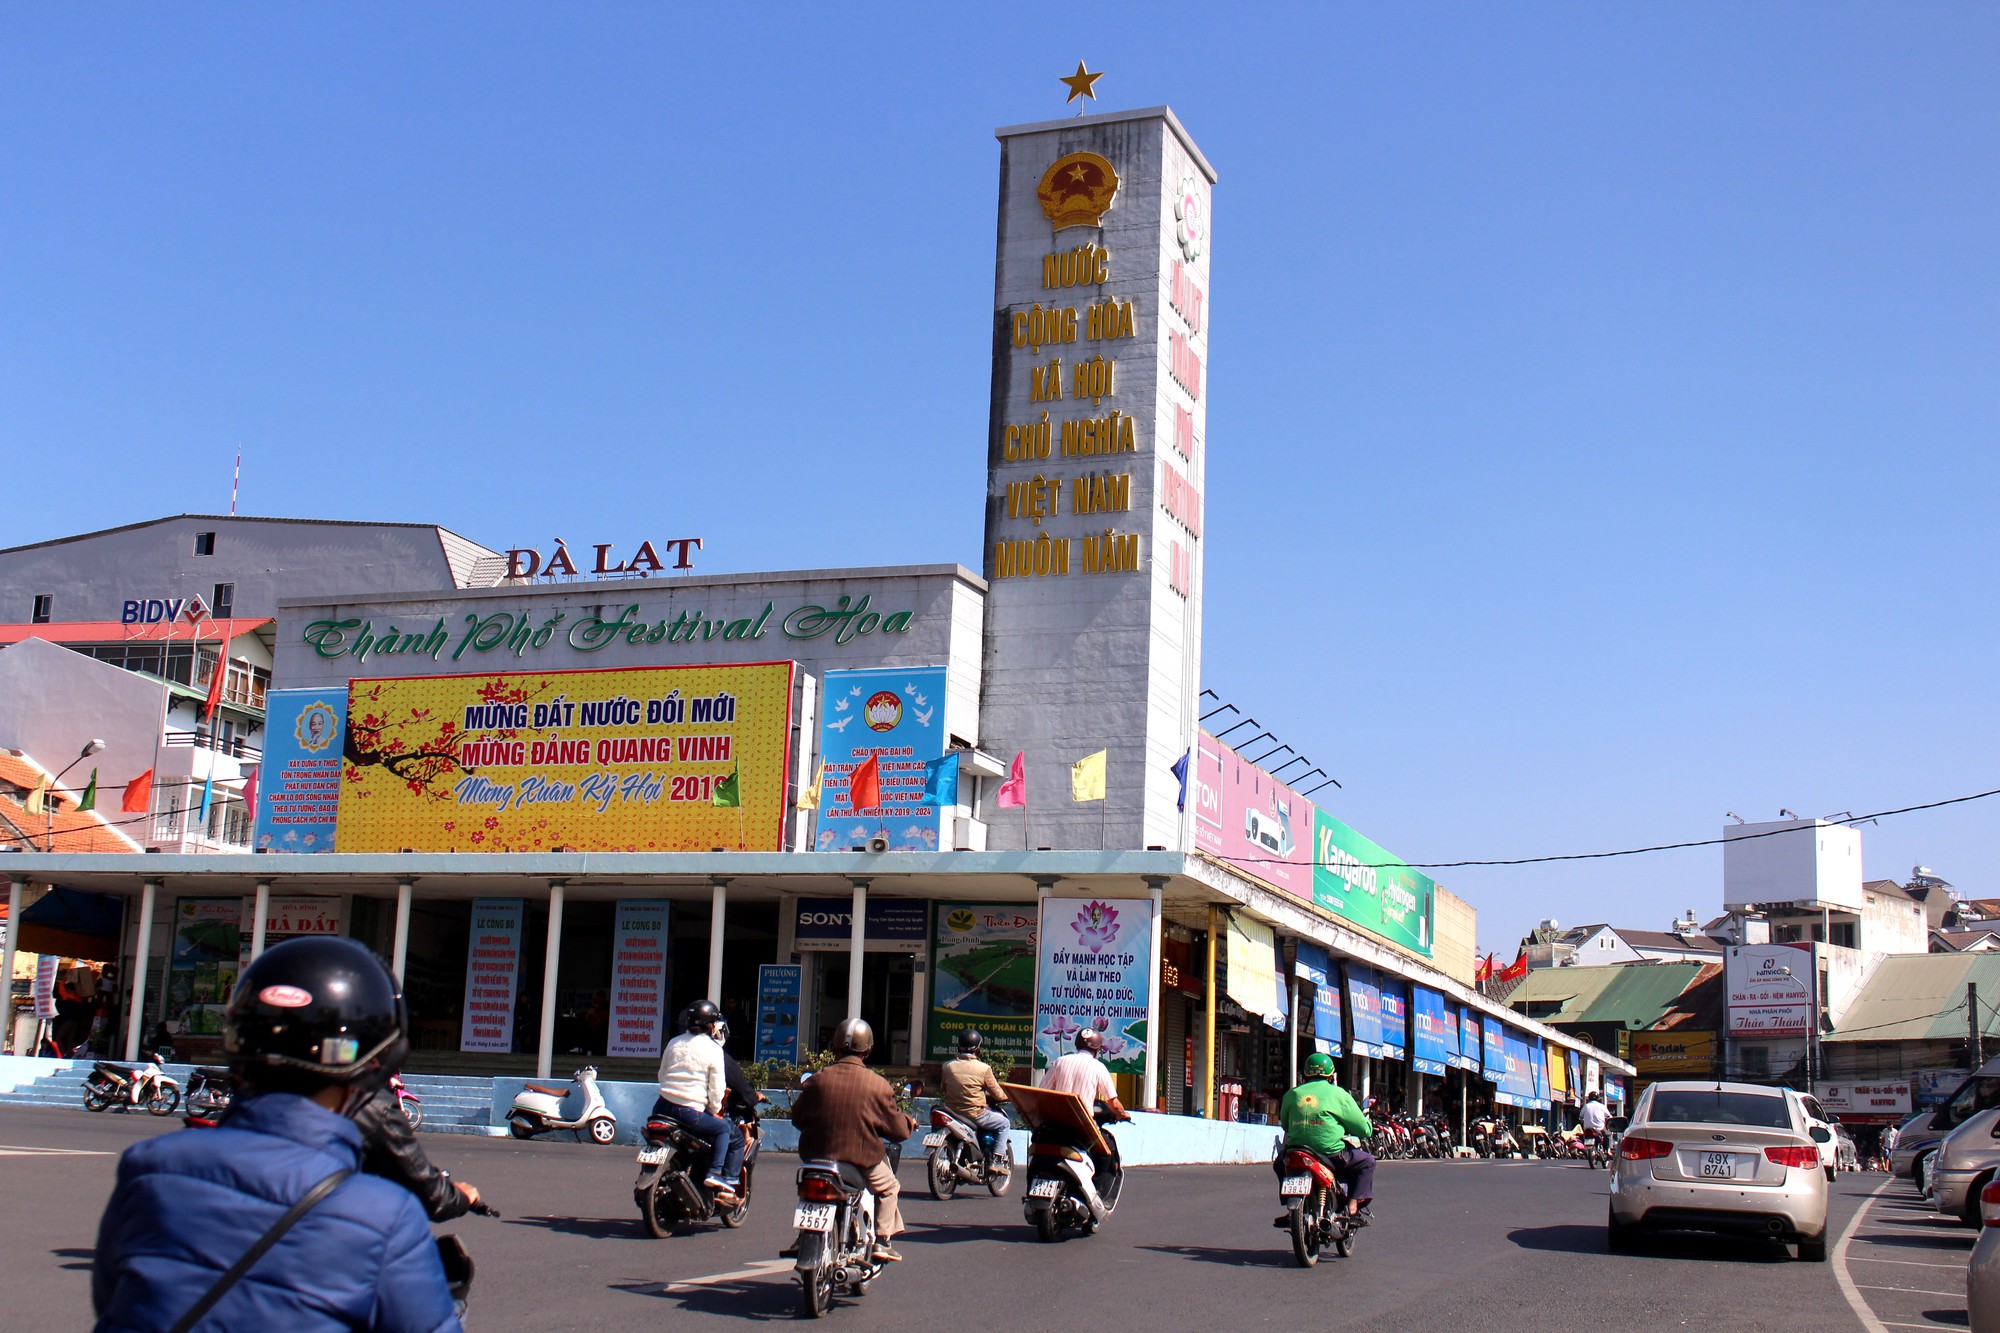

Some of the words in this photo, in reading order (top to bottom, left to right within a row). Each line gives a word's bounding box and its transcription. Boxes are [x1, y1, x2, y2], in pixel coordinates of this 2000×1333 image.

[1043, 241, 1110, 289] NƯỚC
[1012, 303, 1078, 354] CỘNG
[1087, 295, 1137, 341] HÒA
[1031, 358, 1062, 404] XÃ
[1073, 354, 1116, 406] HỘI
[1004, 410, 1053, 461] CHỦ
[1062, 410, 1137, 457] NGHĨA
[1007, 474, 1062, 525] VIỆT
[1073, 474, 1131, 515] NAM
[504, 537, 579, 579] ĐÀ
[591, 538, 703, 577] LẠT
[995, 532, 1070, 579] MUÔN
[1082, 528, 1140, 574] NĂM
[122, 598, 184, 624] BIDV
[305, 616, 450, 664] Thành
[453, 612, 567, 661] Phố
[569, 601, 775, 651] Festival
[783, 594, 915, 645] Hoa
[464, 701, 527, 730] MỪNG
[533, 695, 574, 728] ĐẤT
[580, 695, 641, 726] NƯỚC
[647, 689, 684, 724] ĐỔI
[691, 692, 736, 723] MỚI
[460, 738, 525, 767] MỪNG
[530, 733, 590, 765] ĐẢNG
[596, 739, 670, 764] QUANG
[678, 736, 731, 762] VINH
[896, 761, 911, 771] NAM
[454, 775, 515, 812] Mừng
[515, 774, 575, 809] Xuân
[579, 772, 619, 812] Kỷ
[620, 773, 666, 809] Hợi
[894, 806, 910, 817] 2019
[915, 806, 931, 817] 2024
[297, 911, 340, 931] ĐẤT
[799, 912, 853, 926] SONY
[1053, 947, 1070, 965] ĐẨY
[1072, 953, 1096, 969] MẠNH
[1098, 953, 1116, 970] HỌC
[1118, 952, 1134, 970] TẬP
[764, 967, 797, 978] PHƯƠNG
[1066, 967, 1078, 982] VÀ
[1079, 967, 1097, 983] LÀM
[1099, 971, 1122, 983] THEO
[1051, 986, 1064, 998] TƯ
[1064, 984, 1095, 1001] TƯỞNG,
[1096, 988, 1114, 1003] ĐẠO
[1115, 986, 1135, 1003] ĐỨC,
[1039, 1004, 1067, 1016] PHONG
[1068, 1002, 1093, 1017] CÁCH
[1093, 1000, 1107, 1018] HỒ
[1107, 1002, 1123, 1018] CHÍ
[1124, 1006, 1147, 1019] MINH
[940, 1020, 964, 1030] CÔNG
[1651, 1042, 1688, 1053] Kodak
[1708, 1153, 1728, 1165] 49X
[1704, 1165, 1731, 1176] 8741
[1032, 1187, 1052, 1196] 6144
[799, 1216, 828, 1229] 2567
